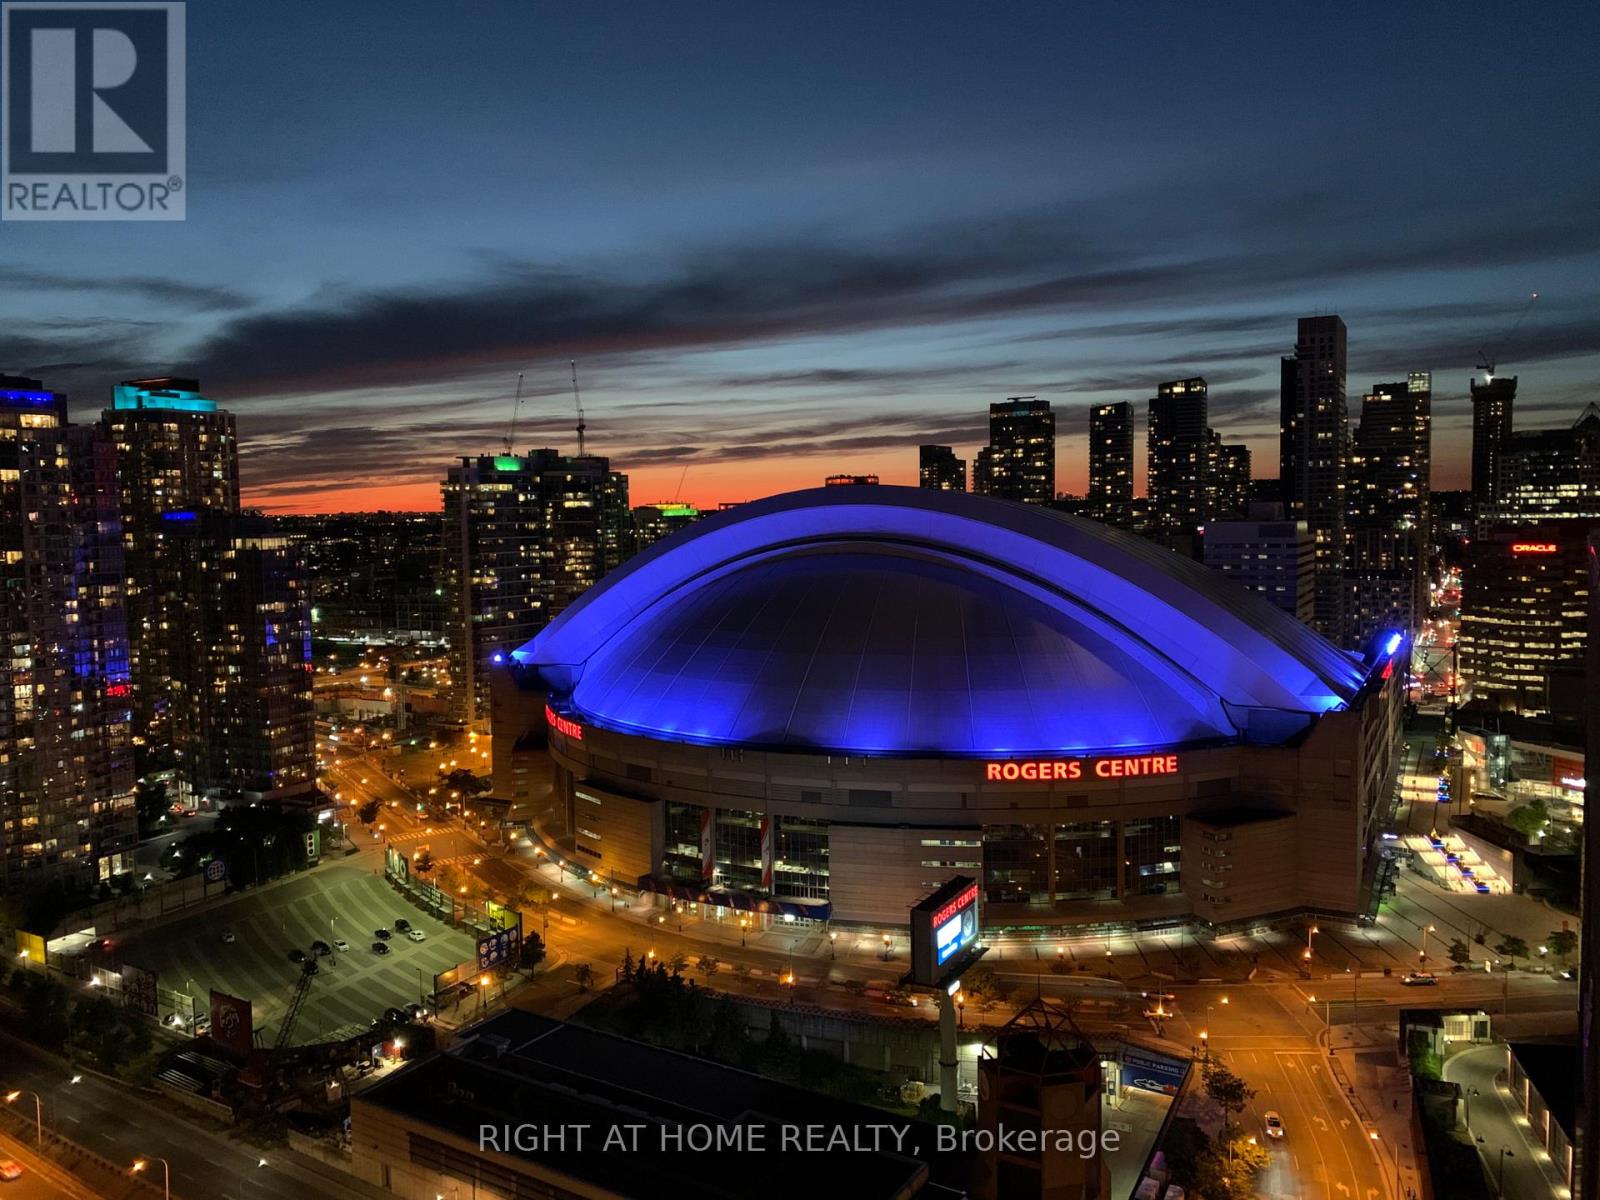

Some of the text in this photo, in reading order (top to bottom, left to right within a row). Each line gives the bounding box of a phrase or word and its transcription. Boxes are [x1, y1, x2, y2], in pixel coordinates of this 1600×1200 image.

[1512, 544, 1557, 552] ORACLE
[557, 716, 582, 740] CENTRE
[987, 755, 1178, 780] ROGERS CENTRE
[933, 884, 978, 928] ROGERS CENTRE
[1151, 1063, 1179, 1074] PARKING
